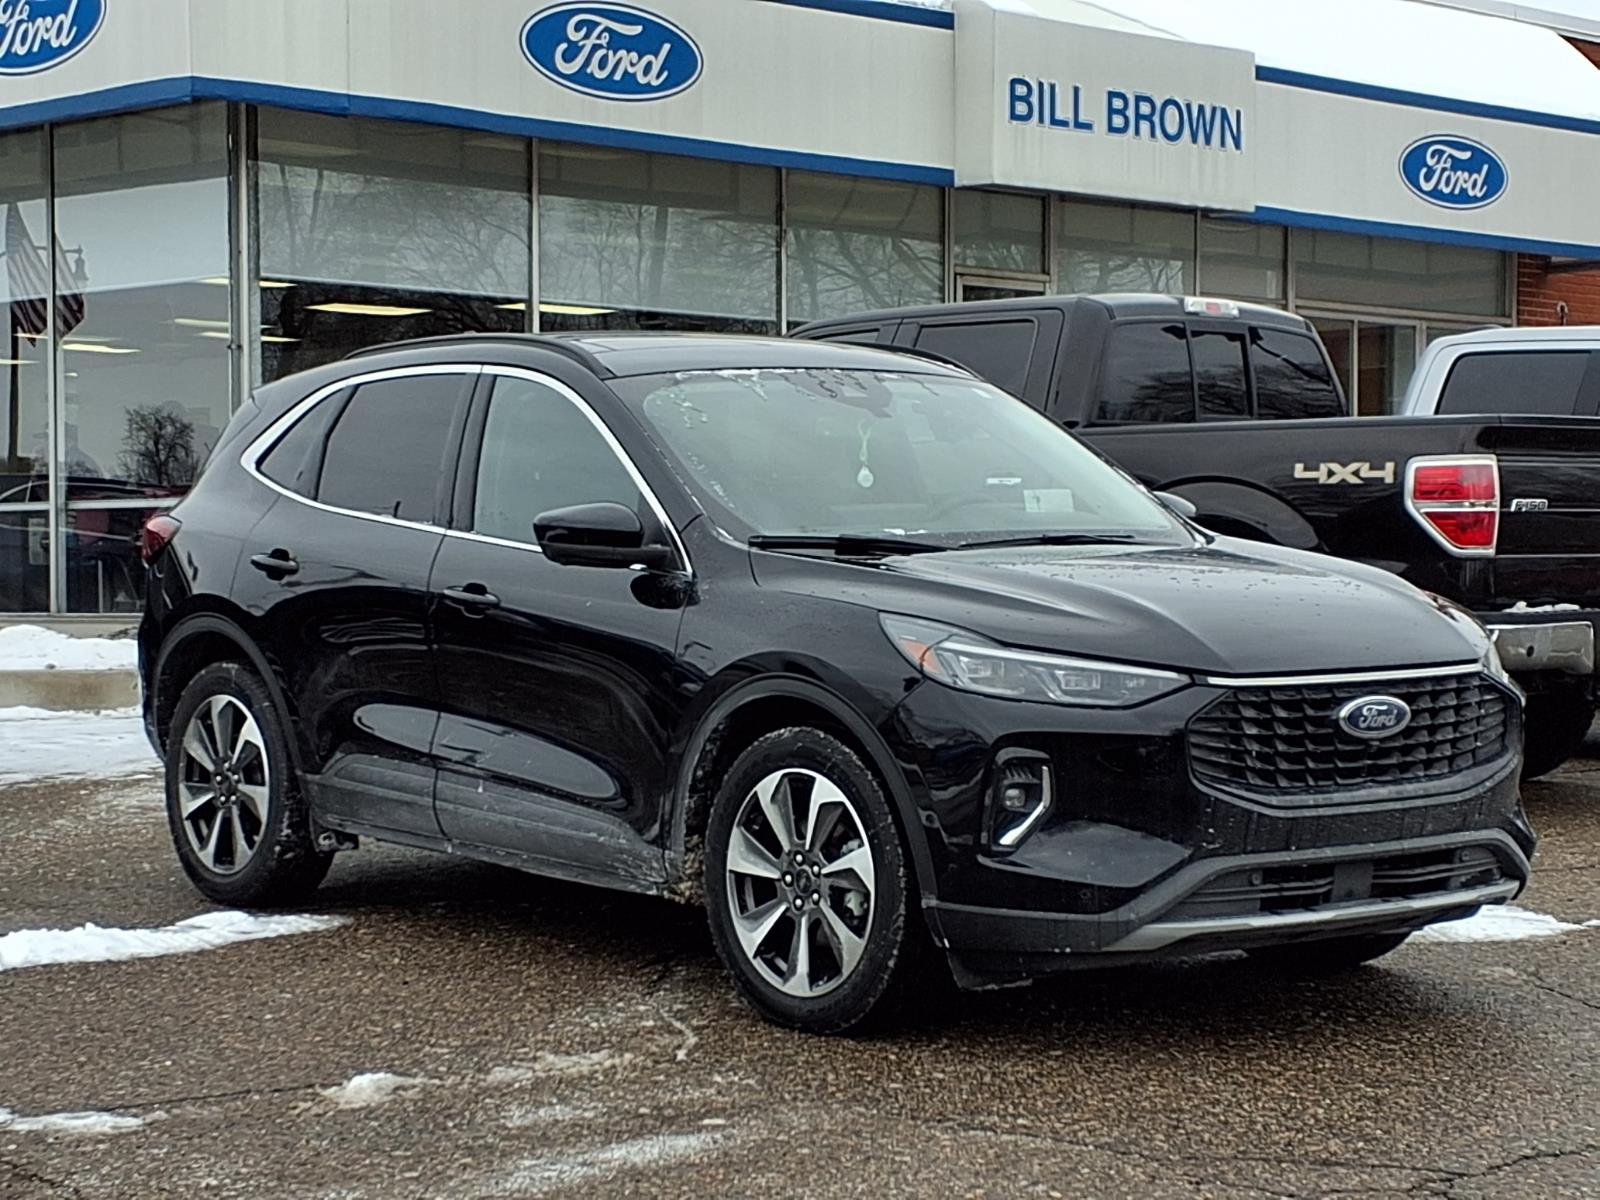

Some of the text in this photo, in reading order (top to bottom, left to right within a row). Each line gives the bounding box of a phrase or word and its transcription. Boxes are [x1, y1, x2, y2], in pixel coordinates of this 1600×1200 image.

[555, 13, 671, 86] Ford
[1009, 77, 1242, 151] BILL BROWN
[1419, 144, 1489, 198] Ford
[1359, 704, 1397, 728] Ford
